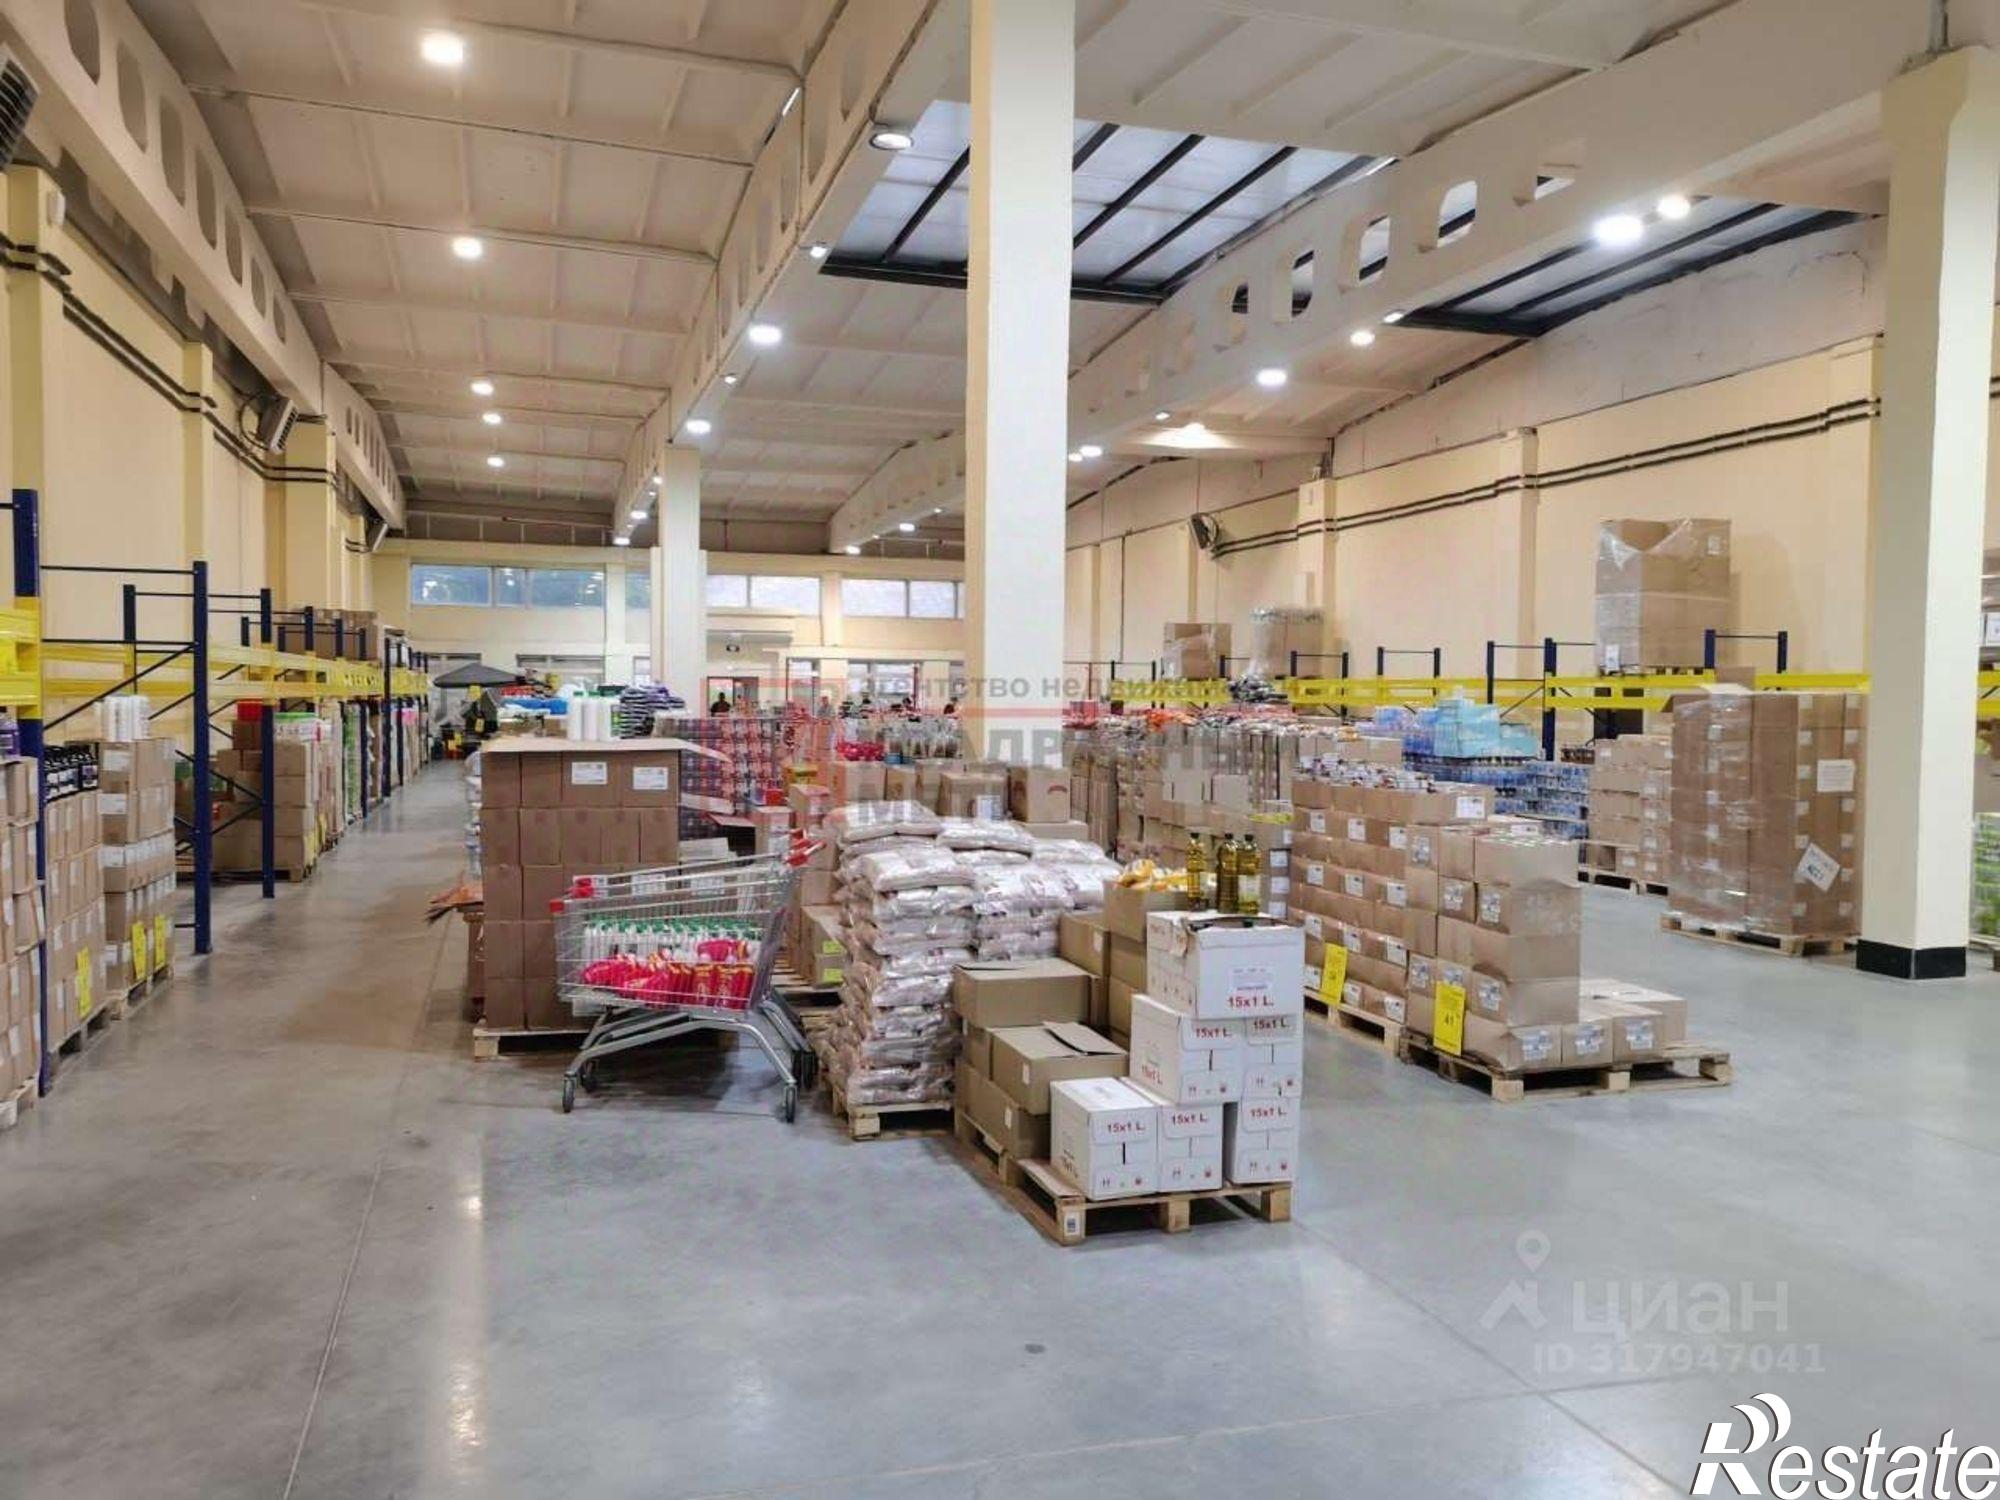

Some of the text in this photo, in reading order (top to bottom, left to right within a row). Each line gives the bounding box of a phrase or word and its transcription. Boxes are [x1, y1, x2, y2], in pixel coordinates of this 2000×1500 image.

[1228, 997, 1258, 1008] 15x1
[1195, 1028, 1220, 1038] 15x1
[1250, 1107, 1275, 1118] 15x1
[1171, 1114, 1196, 1125] 15x1
[1107, 1122, 1132, 1133] 15x1
